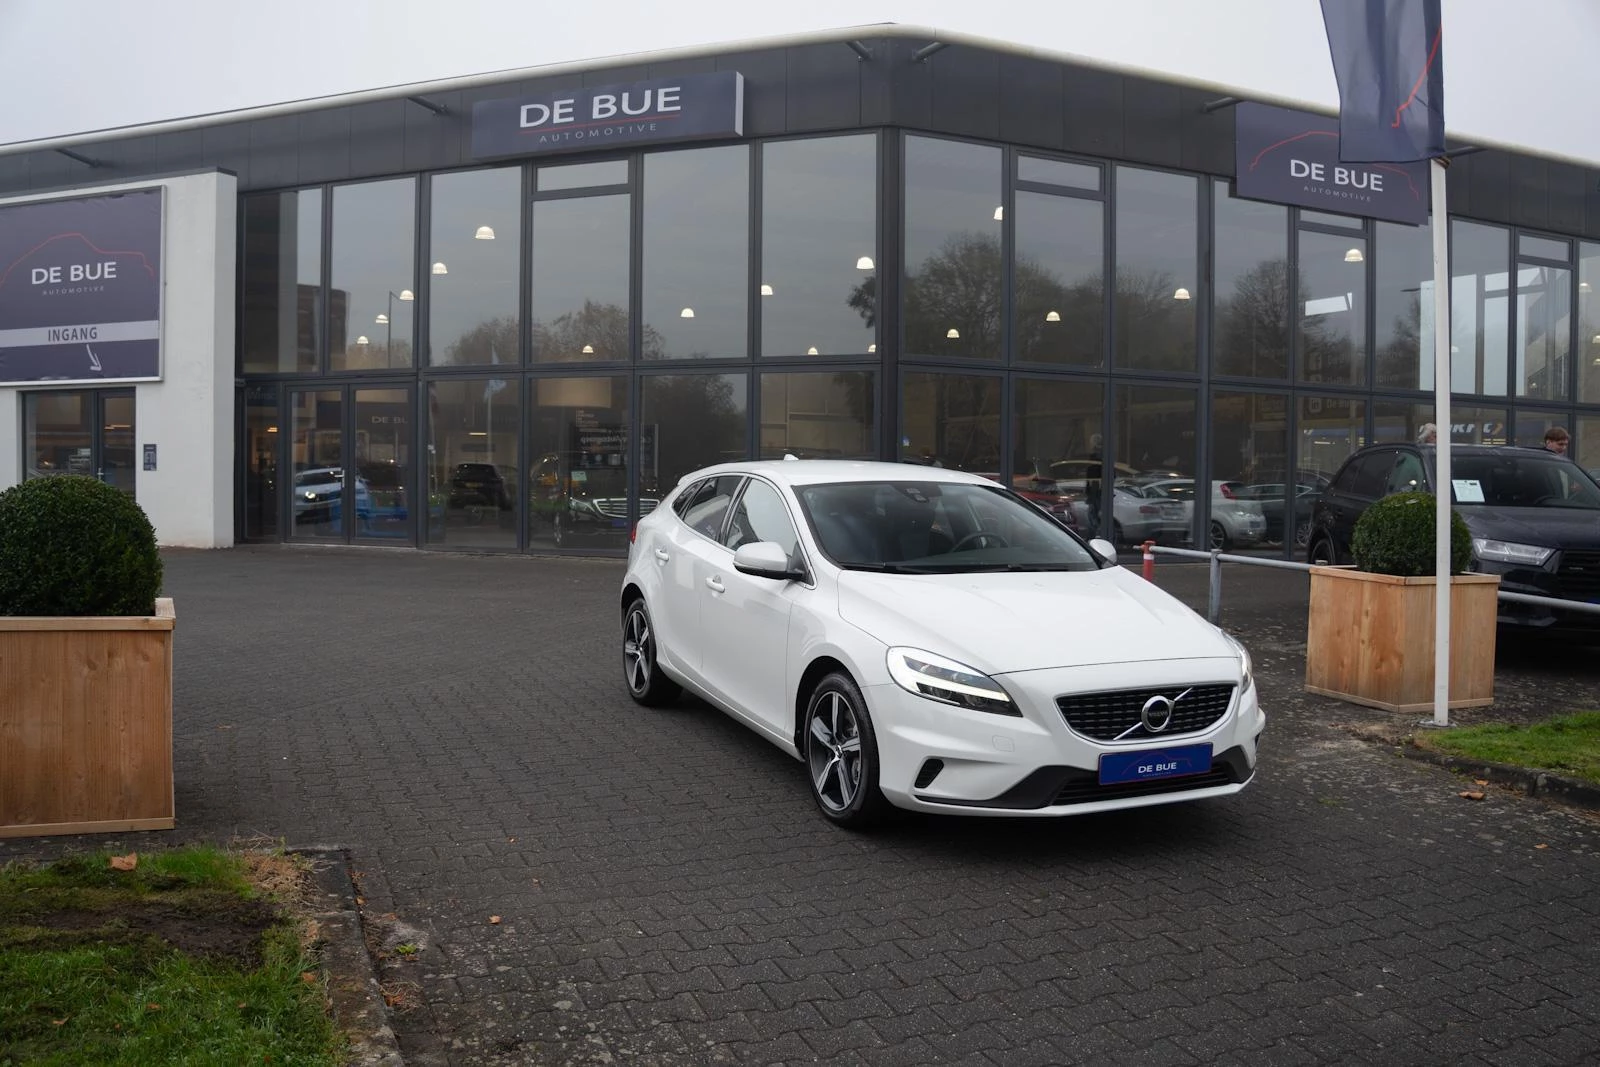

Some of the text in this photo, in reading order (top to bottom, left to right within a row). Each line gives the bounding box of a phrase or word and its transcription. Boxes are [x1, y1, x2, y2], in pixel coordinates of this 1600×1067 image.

[519, 86, 682, 128] DE BUE
[539, 122, 657, 144] AUTOMOTIVE
[1290, 159, 1384, 192] DE BUE
[1303, 185, 1371, 202] AUTOMOTIVE
[31, 261, 117, 285] DE BUE
[47, 326, 98, 342] INGANG
[1138, 765, 1152, 774] DE
[1155, 762, 1177, 771] BUE
